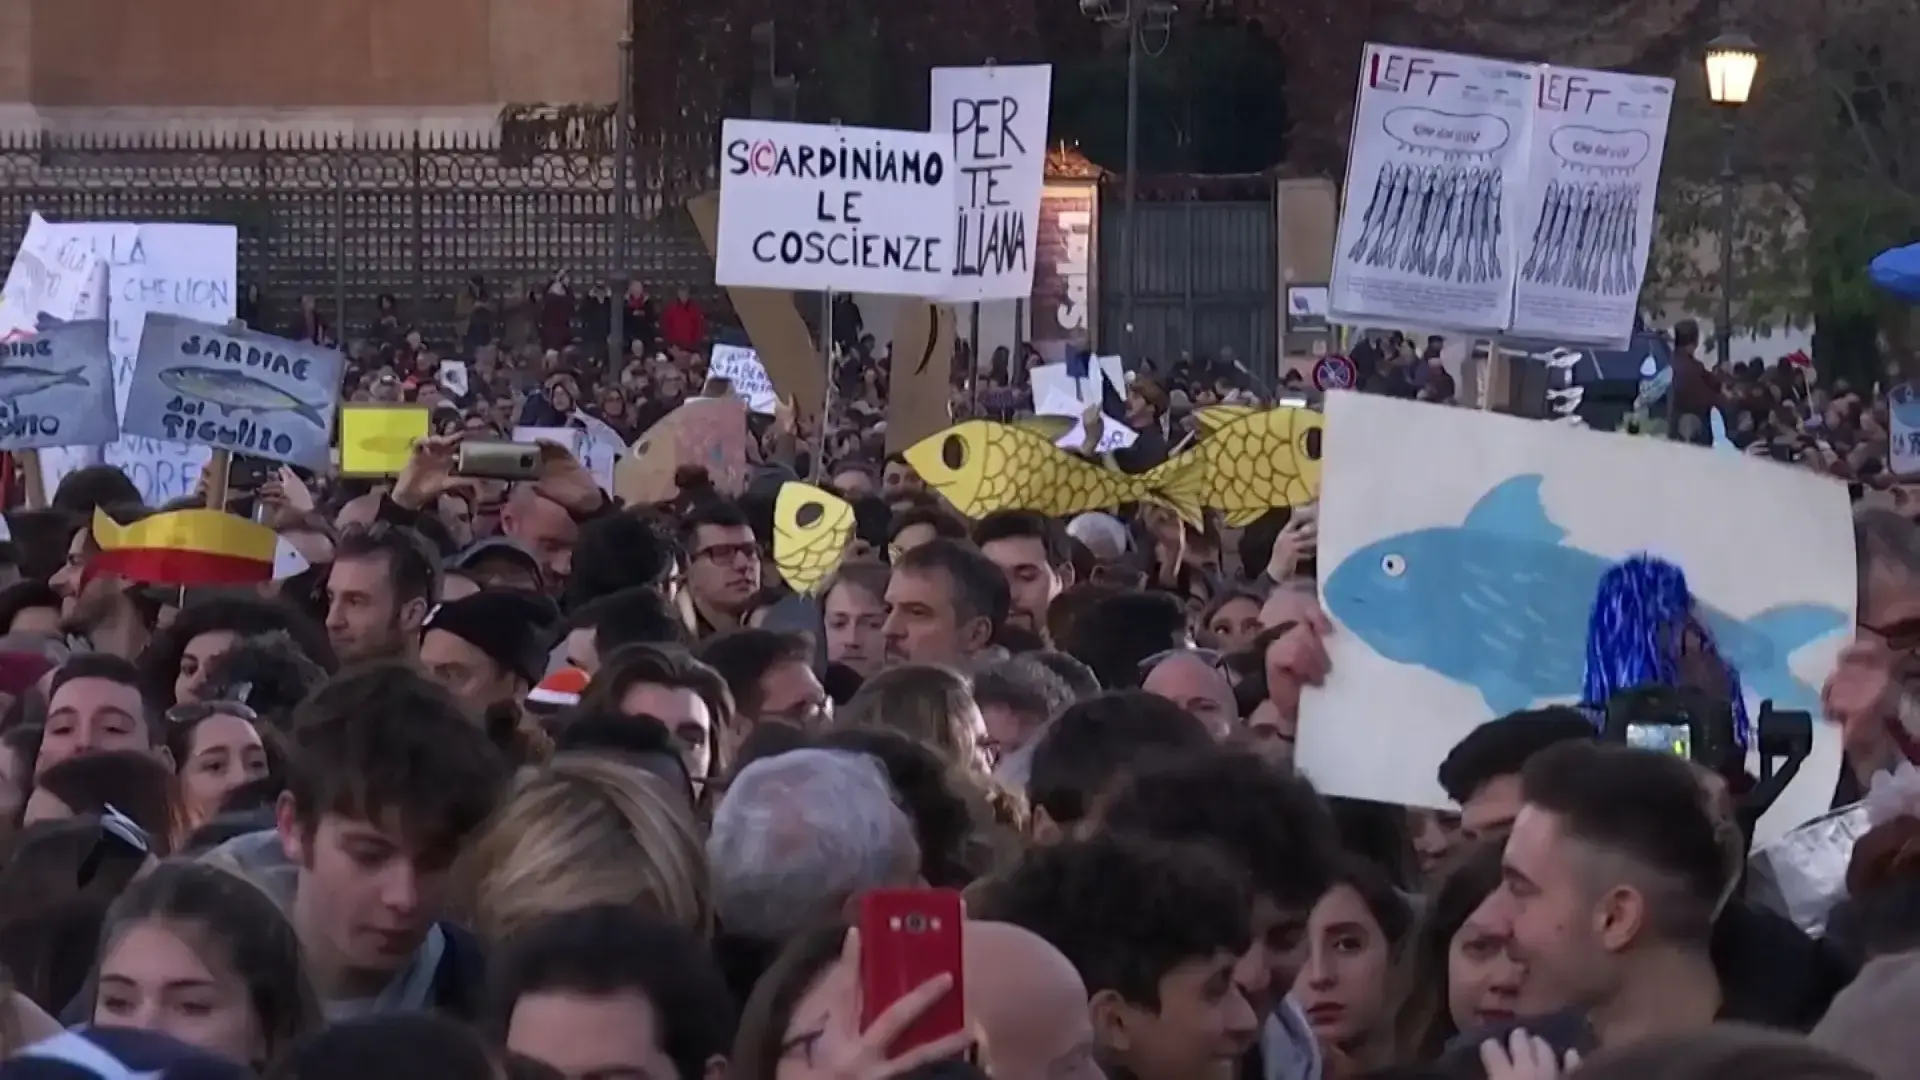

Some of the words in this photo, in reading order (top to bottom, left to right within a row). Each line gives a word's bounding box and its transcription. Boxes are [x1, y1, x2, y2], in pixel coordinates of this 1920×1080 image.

[1369, 52, 1460, 97] LEFT
[1538, 73, 1612, 114] LEFT
[952, 95, 1026, 162] PER
[817, 190, 863, 224] LE
[960, 165, 1013, 208] TE
[752, 226, 942, 273] COSCIENZE
